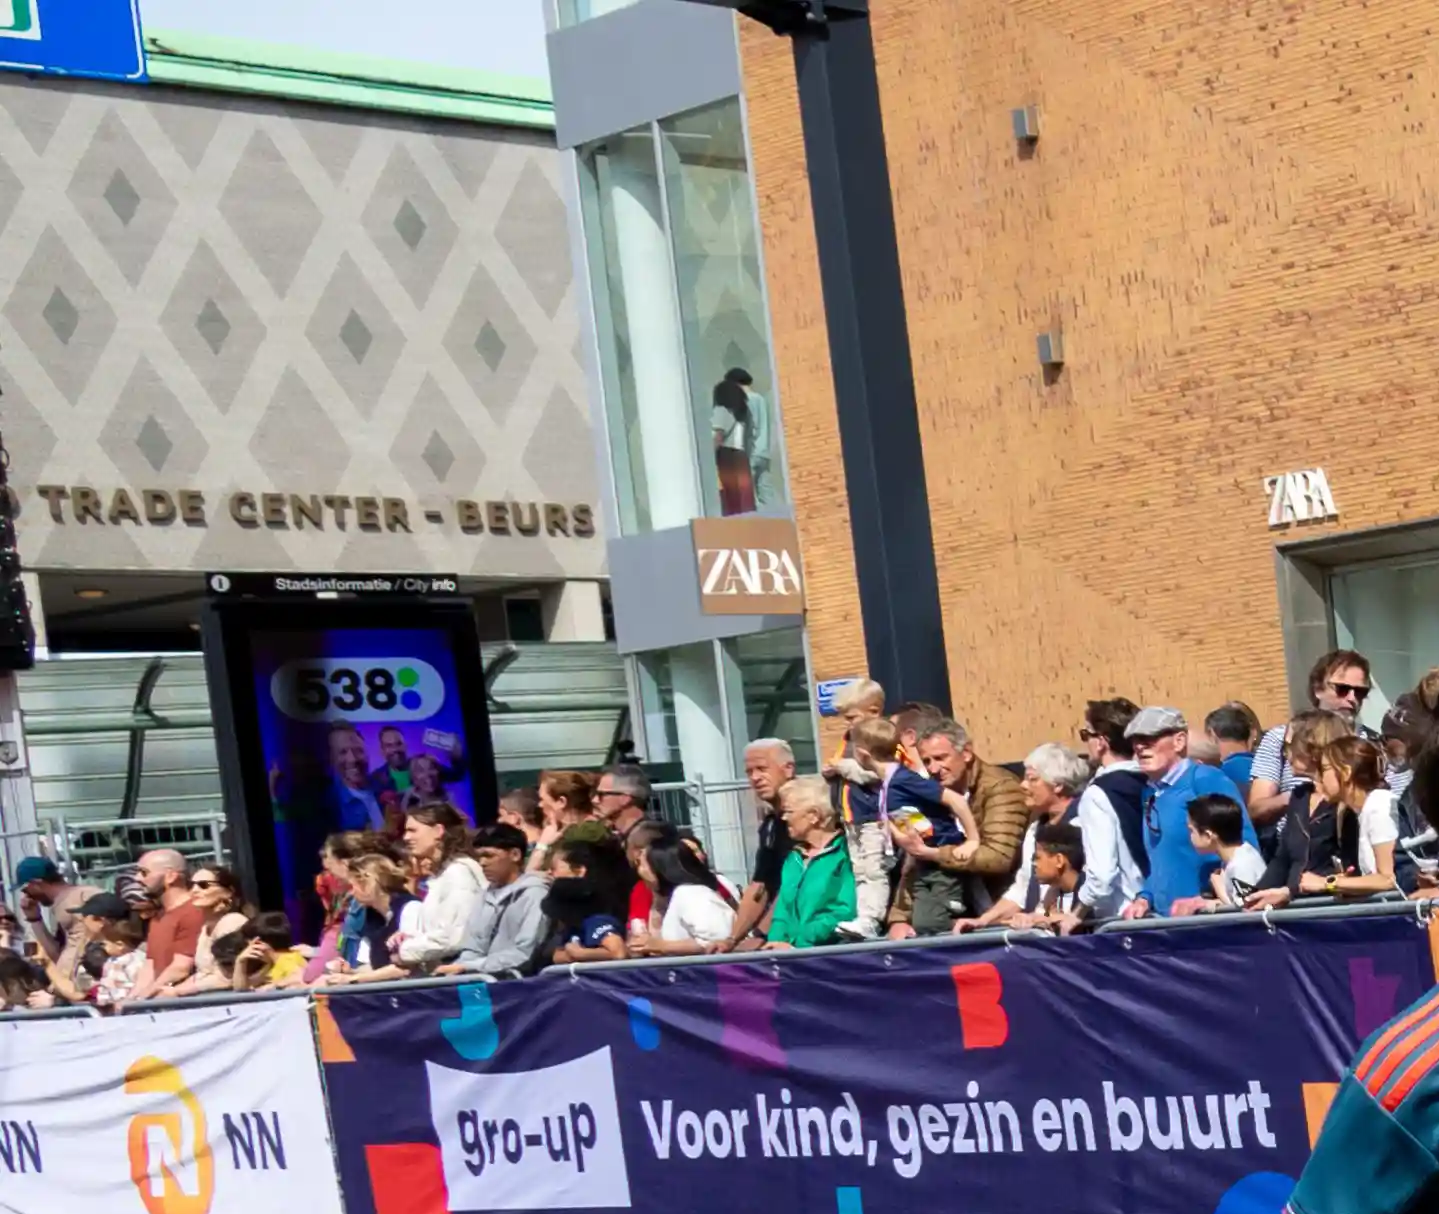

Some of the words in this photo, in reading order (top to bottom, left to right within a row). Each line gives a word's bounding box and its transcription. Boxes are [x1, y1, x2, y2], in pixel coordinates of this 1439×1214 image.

[36, 484, 208, 528] TRADE
[228, 491, 413, 533] CENTER
[455, 499, 597, 539] BEURS
[1263, 467, 1339, 526] ZARA
[275, 577, 392, 591] Stadsinformatie
[403, 578, 430, 593] City
[431, 578, 456, 591] info
[697, 548, 800, 596] ZARA
[297, 667, 397, 712] 538
[222, 1110, 287, 1170] NN
[456, 1101, 598, 1177] gro-up
[640, 1099, 749, 1160] Voor
[755, 1087, 877, 1167] kind,
[887, 1080, 1023, 1178] gezin
[1032, 1097, 1097, 1152] en
[1102, 1080, 1277, 1151] buurt
